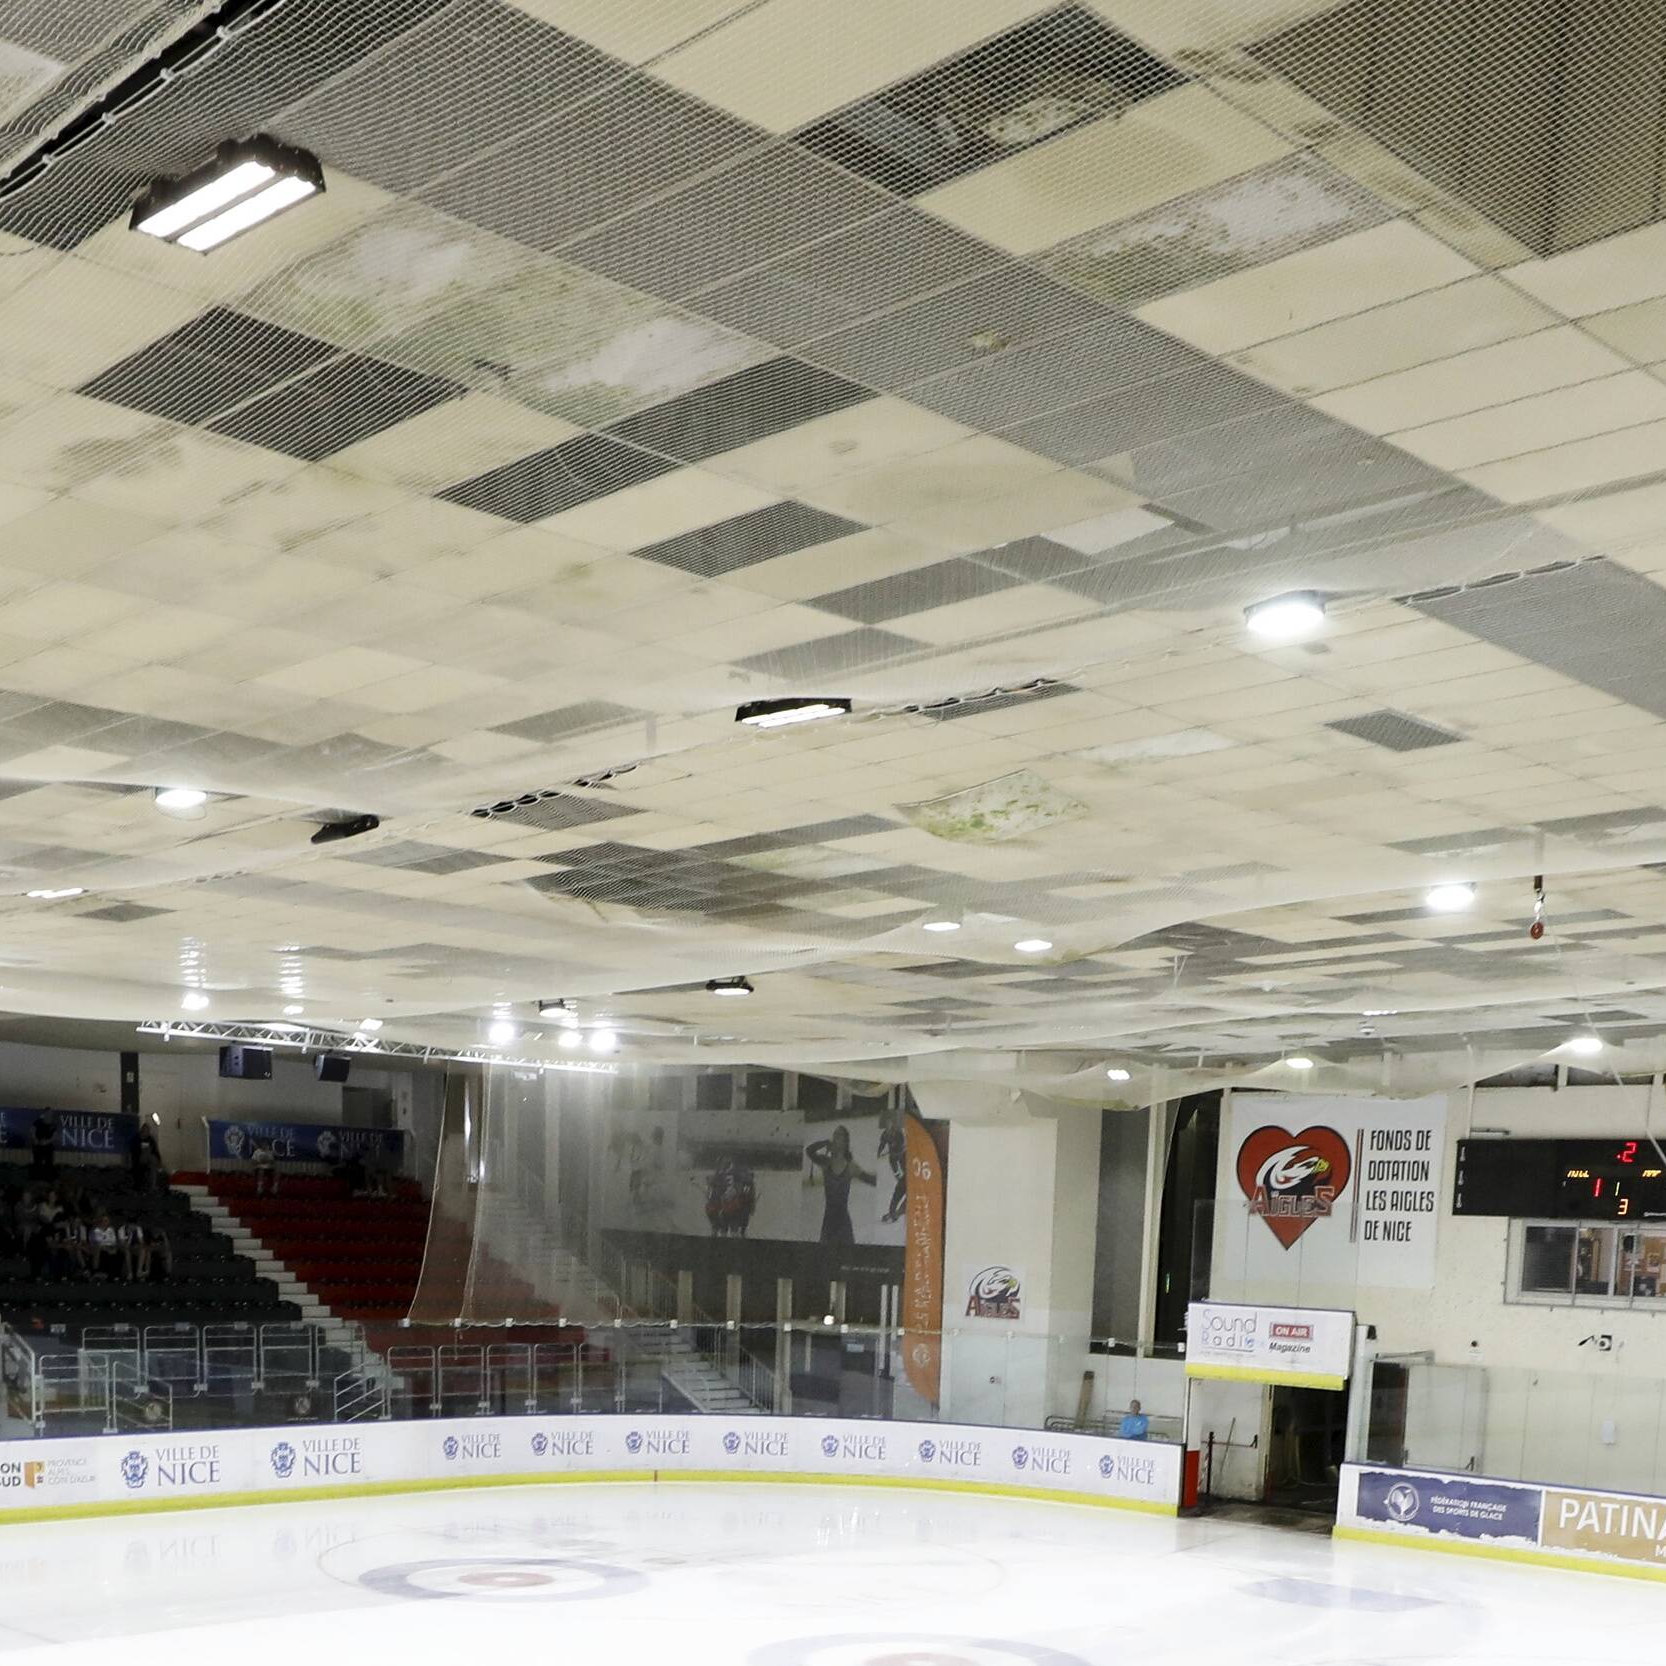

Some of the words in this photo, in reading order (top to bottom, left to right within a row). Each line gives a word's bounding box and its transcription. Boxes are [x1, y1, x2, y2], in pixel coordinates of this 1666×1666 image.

[60, 1113, 92, 1128] VILLE
[97, 1115, 116, 1130] DE
[61, 1127, 116, 1150] NICE
[1370, 1129, 1412, 1151] FONDS
[1416, 1129, 1432, 1151] DE
[1368, 1160, 1430, 1181] DOTATION
[1366, 1190, 1387, 1211] LES
[1391, 1190, 1434, 1212] AIGLES
[1617, 1198, 1629, 1215] 3
[1364, 1220, 1379, 1241] DE
[1382, 1220, 1412, 1242] NICE
[1202, 1309, 1258, 1334] Sound
[1275, 1326, 1290, 1336] ON
[1291, 1327, 1309, 1338] AIR
[1269, 1341, 1311, 1354] Magazine
[461, 1433, 486, 1445] VILLE
[487, 1433, 501, 1445] DE
[551, 1431, 578, 1442] VILLE
[580, 1430, 594, 1442] DE
[645, 1430, 672, 1441] VILLE
[675, 1430, 690, 1441] DE
[744, 1431, 771, 1442] VILLE
[775, 1432, 789, 1443] DE
[842, 1434, 870, 1445] VILLE
[871, 1435, 886, 1446] DE
[302, 1439, 339, 1453] VILLE
[344, 1437, 361, 1451] DE
[461, 1443, 501, 1459] NICE
[552, 1440, 594, 1456] NICE
[646, 1439, 690, 1454] NICE
[744, 1440, 789, 1456] NICE
[842, 1444, 886, 1461] NICE
[938, 1439, 965, 1451] VILLE
[967, 1441, 982, 1452] DE
[1031, 1446, 1056, 1458] VILLE
[1058, 1448, 1072, 1459] DE
[156, 1447, 195, 1462] VILLE
[200, 1445, 220, 1460] DE
[939, 1450, 982, 1467] NICE
[304, 1451, 361, 1476] NICE
[1032, 1457, 1072, 1475] NICE
[1117, 1455, 1142, 1467] VILLE
[1143, 1457, 1156, 1469] DE
[157, 1461, 220, 1486] NICE
[1117, 1465, 1154, 1485] NICE
[1432, 1505, 1445, 1514] DES
[1446, 1507, 1469, 1517] SPORTS
[1470, 1509, 1480, 1518] DE
[1480, 1510, 1504, 1521] GLACE
